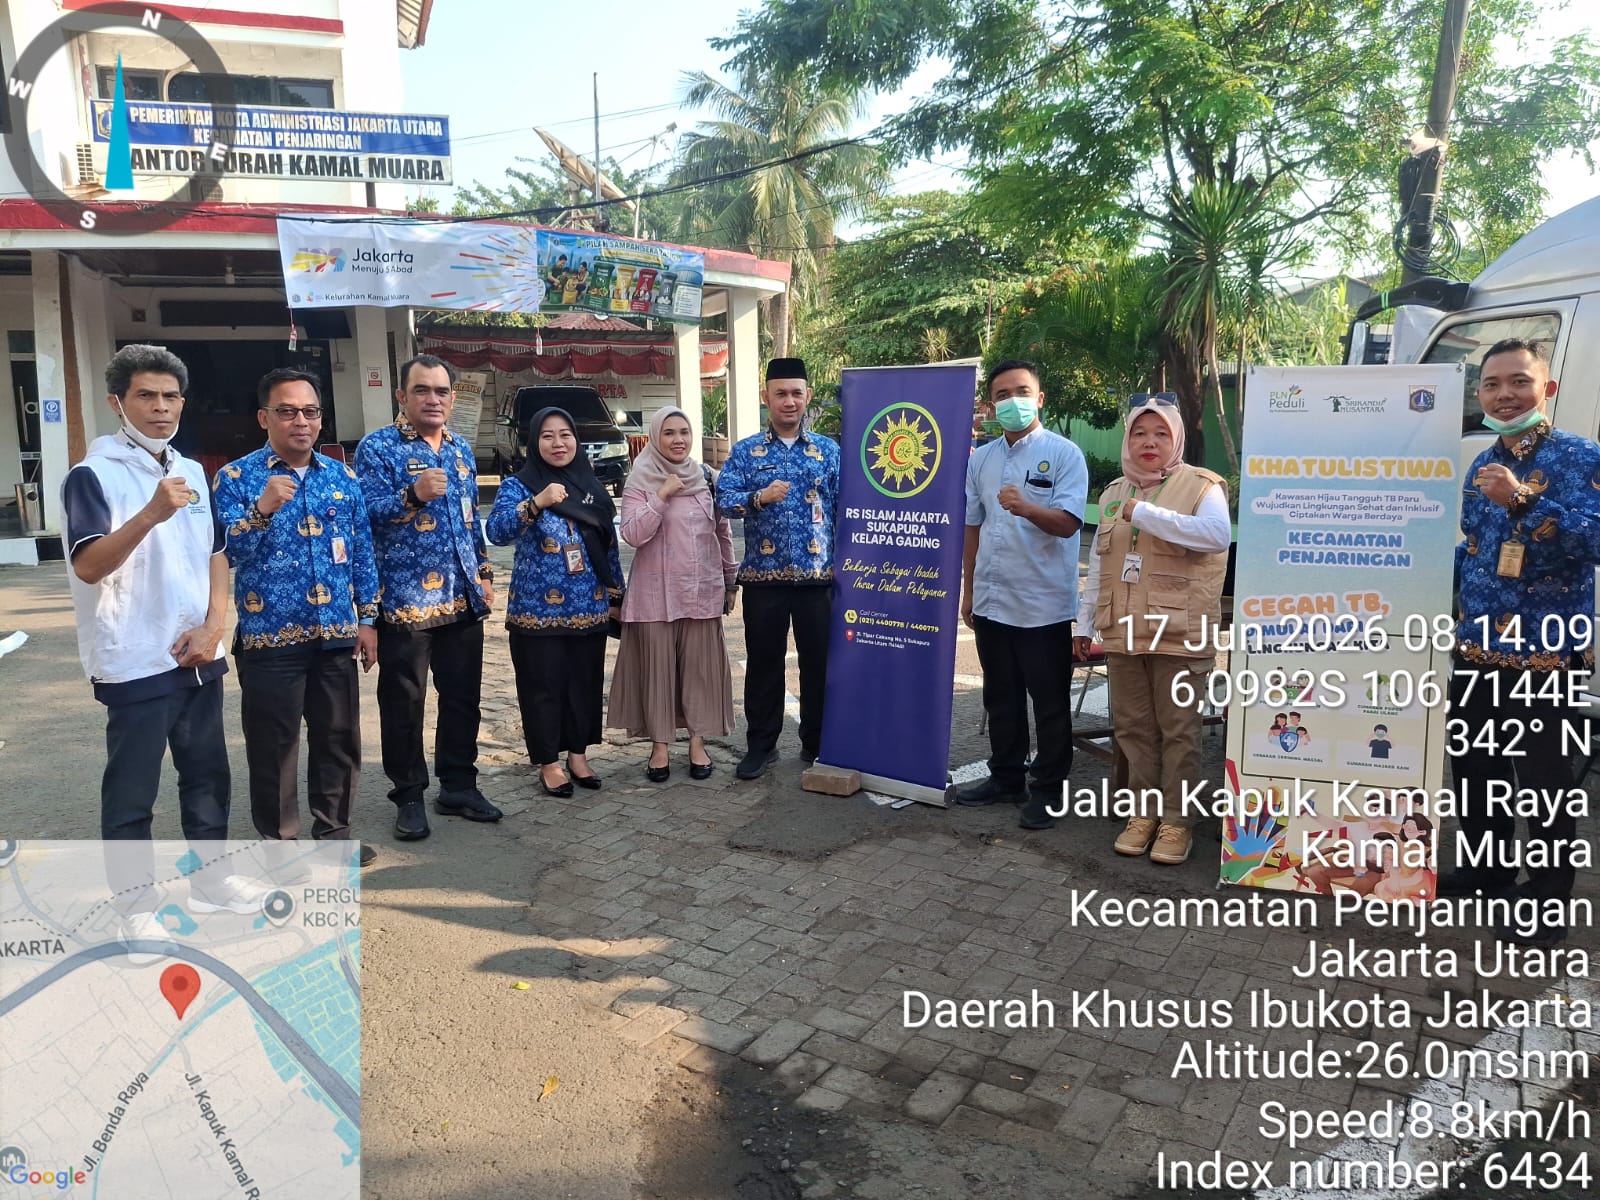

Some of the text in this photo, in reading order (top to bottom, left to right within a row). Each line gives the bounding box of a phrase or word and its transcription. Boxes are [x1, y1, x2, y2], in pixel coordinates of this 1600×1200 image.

[129, 106, 443, 137] PEMERINTAH KOTA ADMINISTRASI JAKARTA UTARA
[194, 127, 362, 150] KECAMATAN PENJARINGAN
[130, 148, 205, 173] ANTOR
[289, 153, 363, 178] KAMAL
[368, 156, 445, 181] MUARA
[610, 240, 640, 251] SAMPAH
[352, 247, 414, 263] Jakarta
[351, 264, 384, 275] Menuju
[391, 265, 413, 274] Abad
[325, 292, 365, 301] Kelurahan
[367, 292, 390, 301] Kamal
[1269, 391, 1288, 399] PLN
[1269, 398, 1305, 409] Peduli
[1247, 457, 1454, 479] KHATULISTIWA
[1256, 501, 1301, 510] Wujudkan
[1303, 502, 1356, 511] Lingkungan
[1386, 504, 1404, 512] dan
[1405, 504, 1440, 512] Inklusif
[1317, 493, 1340, 502] Hijau
[1342, 494, 1382, 503] Tangguh
[1398, 495, 1420, 503] Paru
[845, 507, 950, 525] RS ISLAM JAKARTA
[1289, 510, 1403, 521] Ciptakan Warga Berdaya
[866, 521, 927, 535] SUKAPURA
[851, 532, 940, 549] KELAPA GADING
[1288, 531, 1403, 548] KECAMATAN
[1278, 550, 1411, 567] PENJARINGAN
[842, 558, 940, 580] Bekerja Sebagai Ibadah
[878, 578, 903, 593] Dalam
[906, 581, 947, 600] Pelayanan
[1242, 592, 1390, 617] CEGAH TB,
